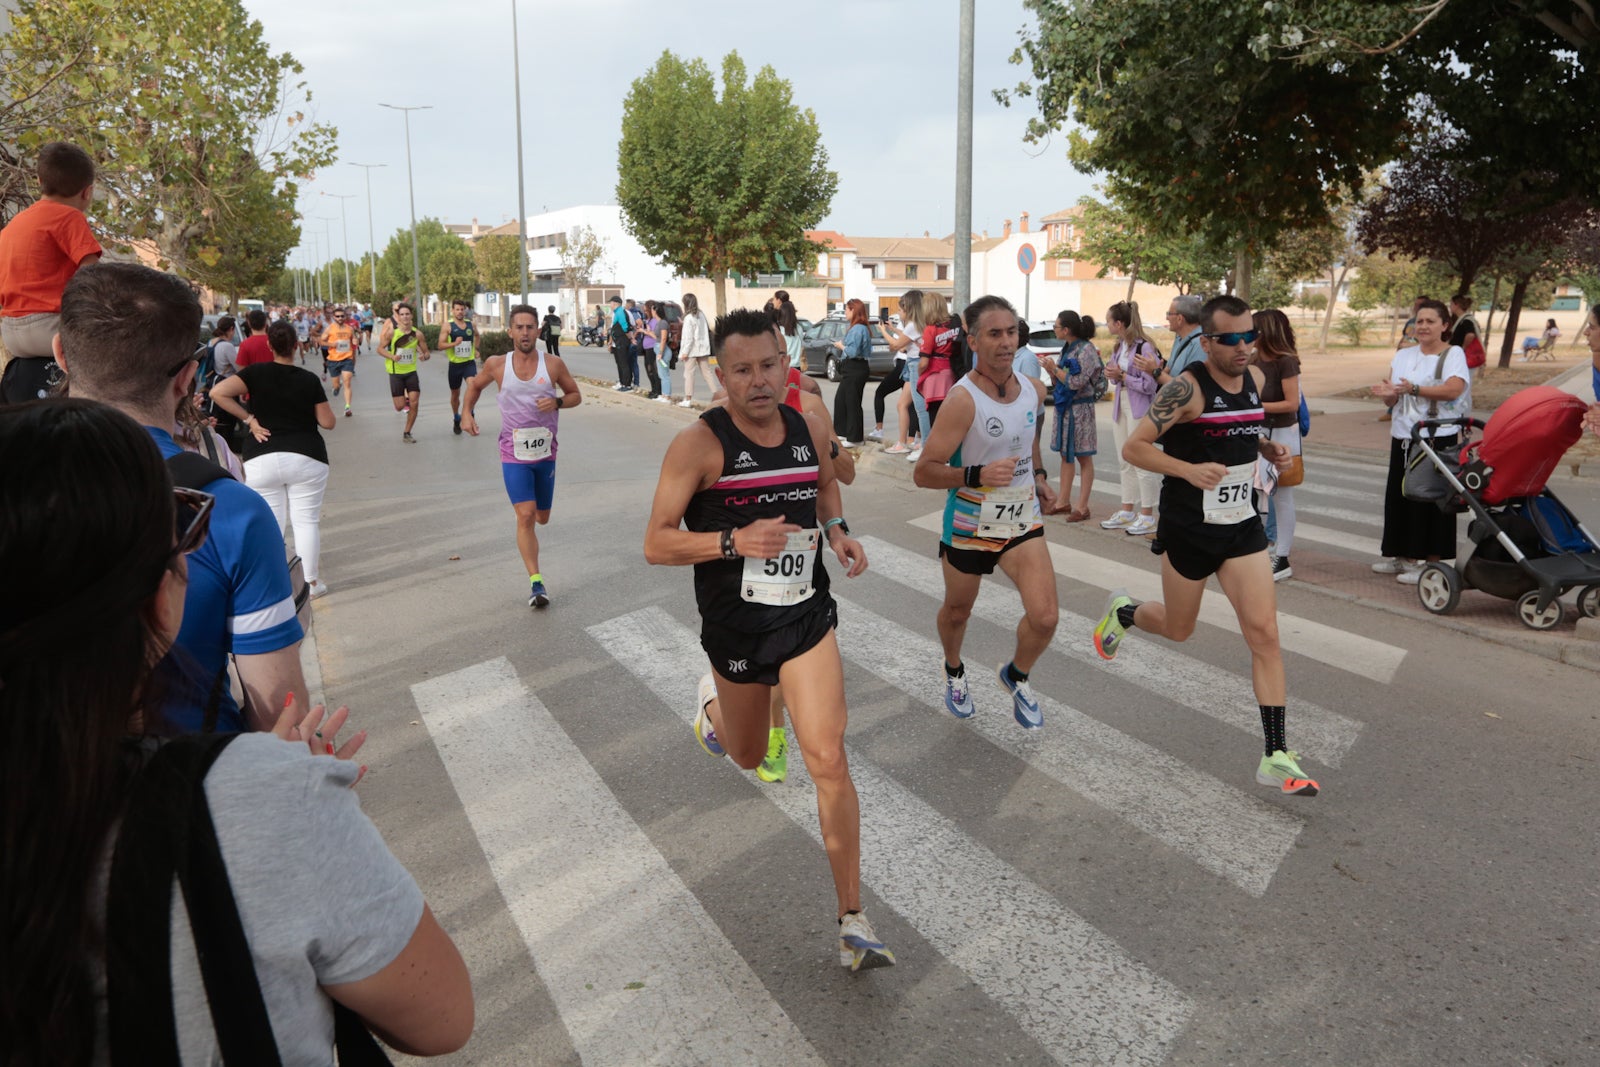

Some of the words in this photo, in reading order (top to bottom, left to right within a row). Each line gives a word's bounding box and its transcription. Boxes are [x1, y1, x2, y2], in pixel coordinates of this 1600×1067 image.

[523, 438, 545, 449] 140
[1218, 482, 1249, 503] 578
[995, 503, 1024, 520] 714
[764, 554, 804, 576] 509
